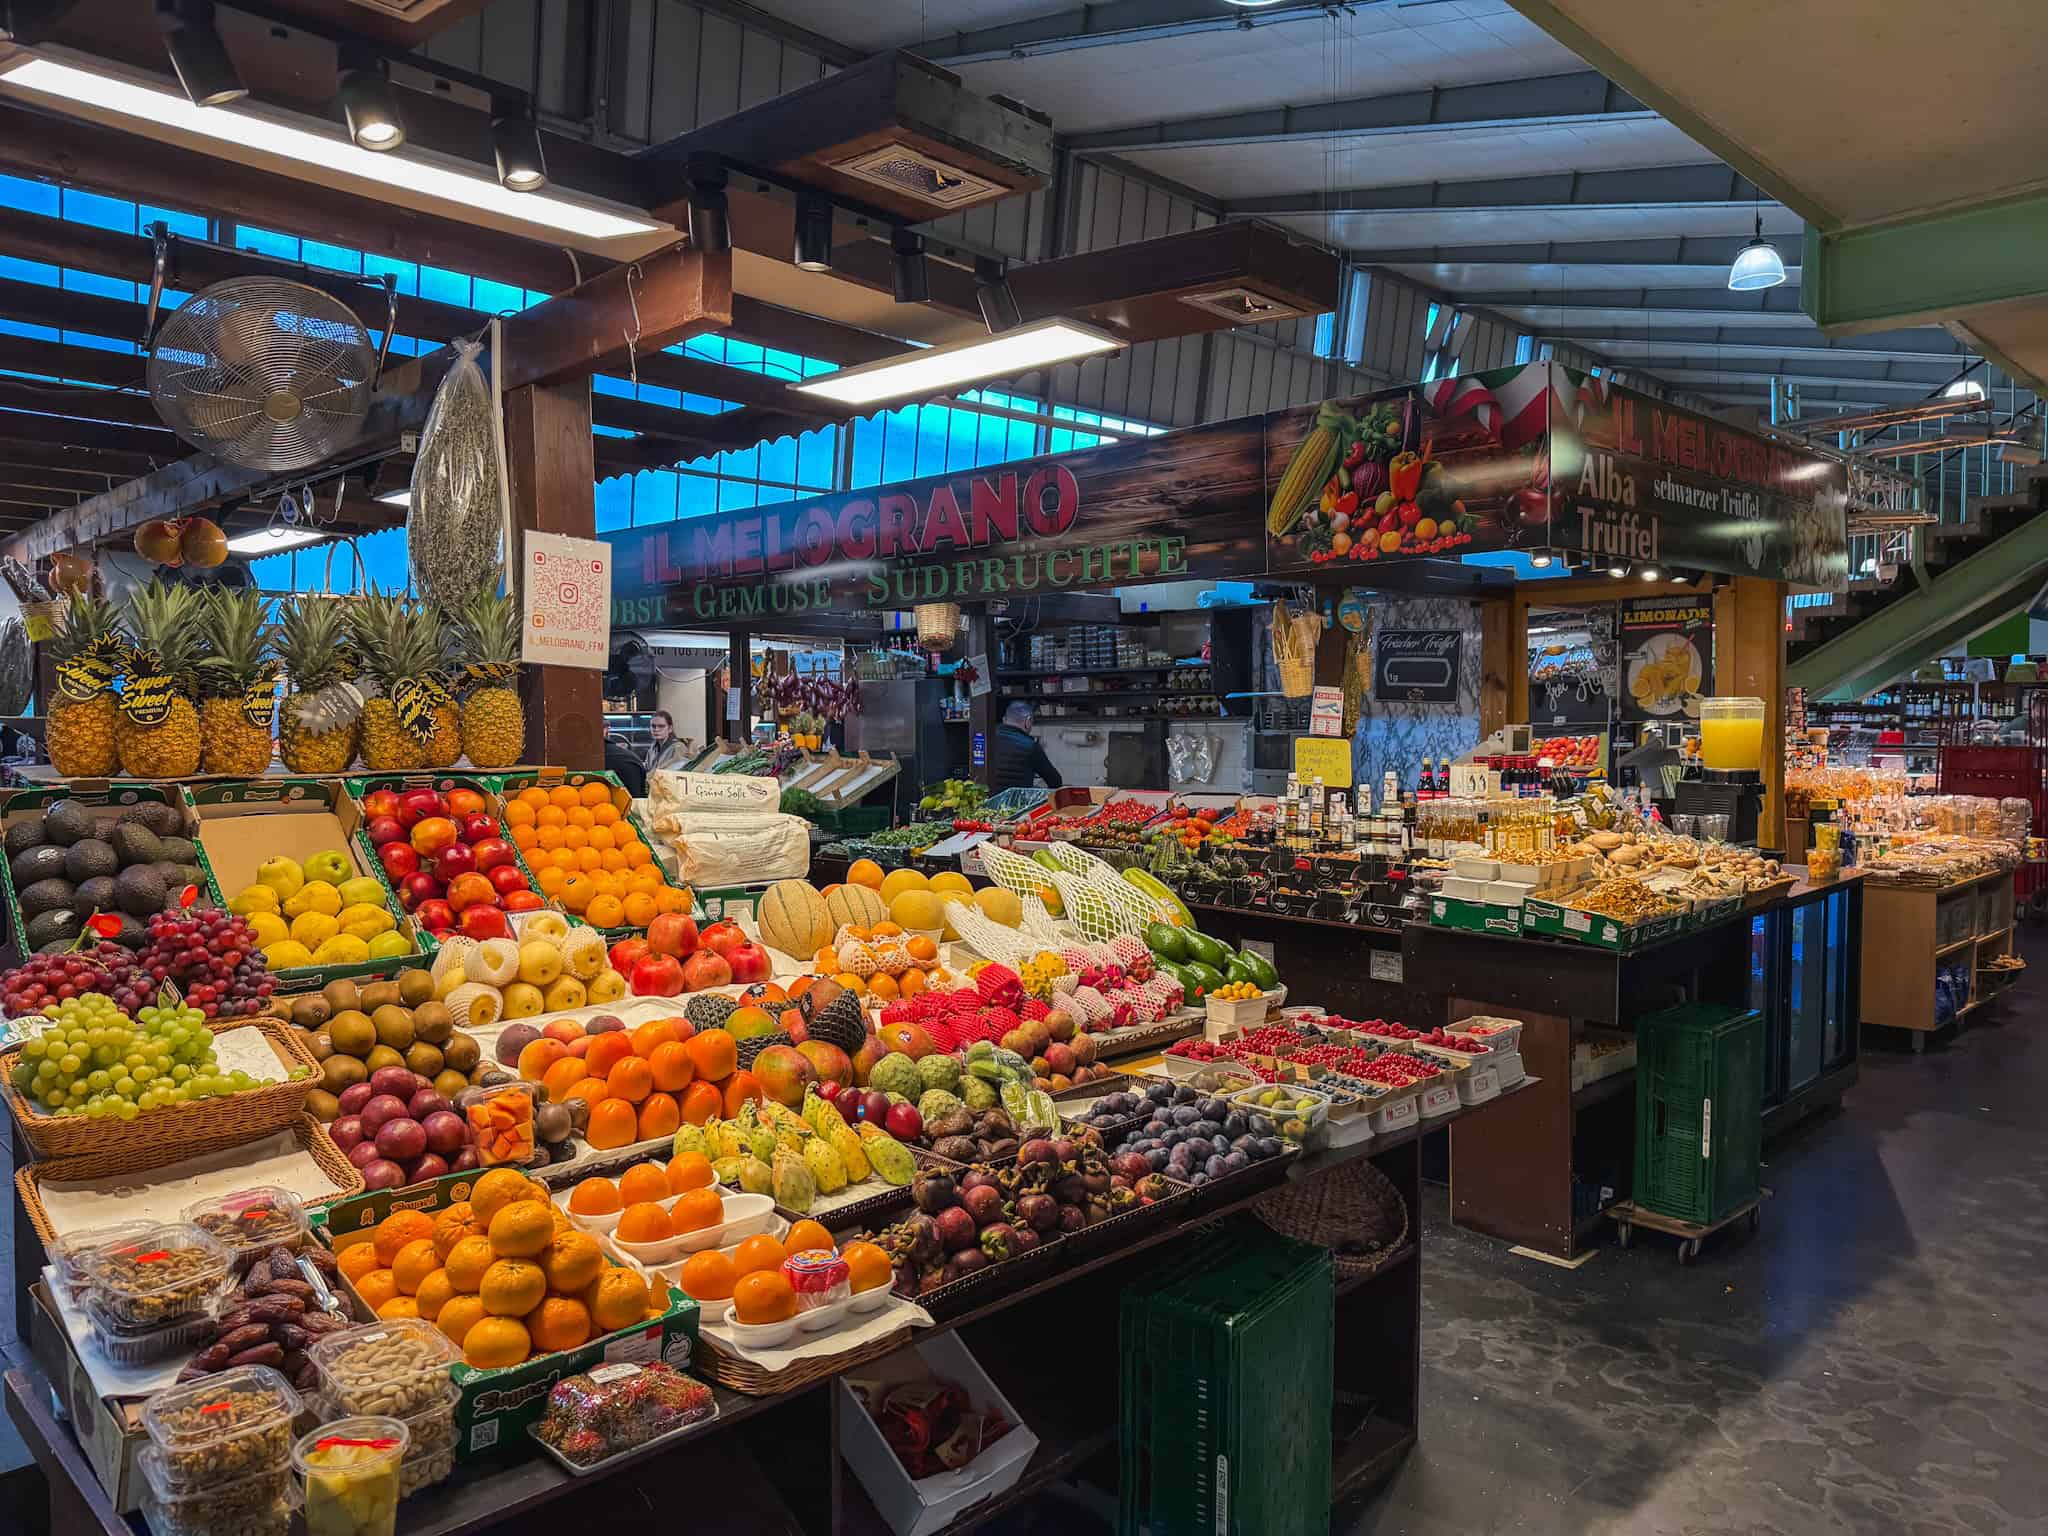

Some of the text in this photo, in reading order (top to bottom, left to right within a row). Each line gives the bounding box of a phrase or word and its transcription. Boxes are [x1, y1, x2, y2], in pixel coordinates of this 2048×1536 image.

[1613, 393, 1643, 456] IL
[1578, 453, 1637, 506] Alba
[1653, 471, 1760, 521] schwarzer Trüffel
[643, 463, 1080, 586] IL MELOGRANO
[1576, 506, 1659, 561] Trüffel
[866, 535, 1189, 604] SÜDFRÜCHTE
[1623, 607, 1711, 624] LIMONADE
[55, 660, 111, 690] Sweet
[119, 688, 175, 710] Sweet
[123, 673, 173, 693] Super
